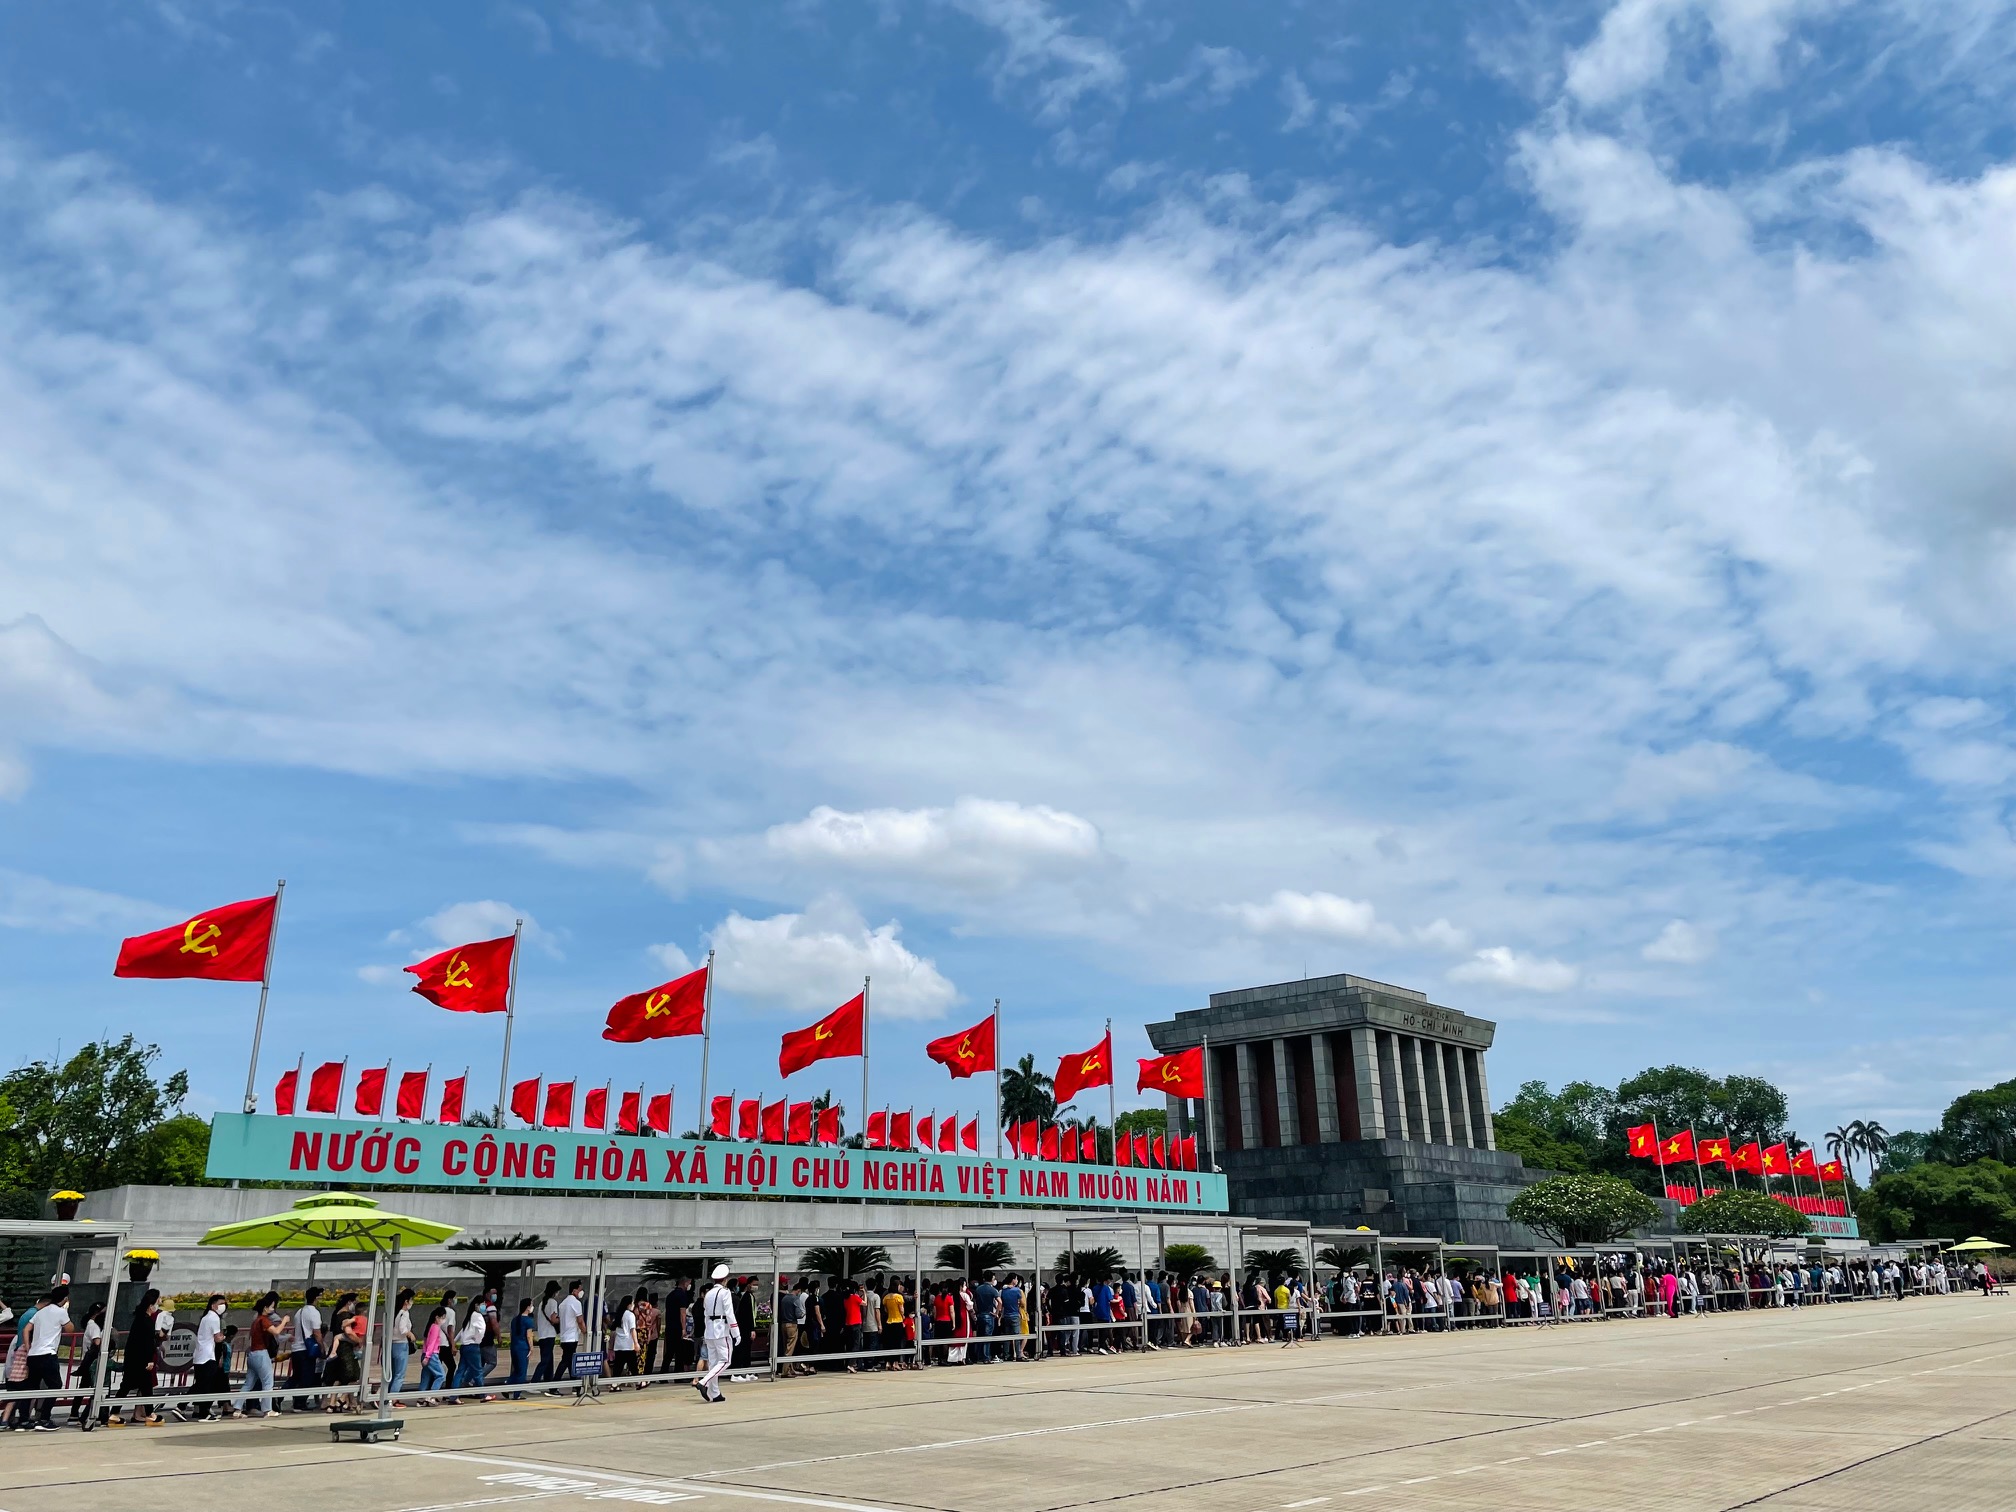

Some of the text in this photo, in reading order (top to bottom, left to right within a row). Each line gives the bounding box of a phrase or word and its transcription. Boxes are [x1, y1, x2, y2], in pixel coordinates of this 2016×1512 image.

[290, 1127, 421, 1175] NƯỚC
[442, 1133, 556, 1184] CỘNG
[574, 1140, 648, 1182] HÒA
[664, 1145, 709, 1184] XÃ
[724, 1148, 777, 1192] HỘI
[792, 1150, 850, 1189] CHỦ
[863, 1158, 945, 1193] NGHĨA
[957, 1162, 1009, 1200] VIỆT
[1020, 1169, 1069, 1198] NAM
[1078, 1170, 1138, 1201] MUÔN
[1146, 1173, 1188, 1204] NĂM
